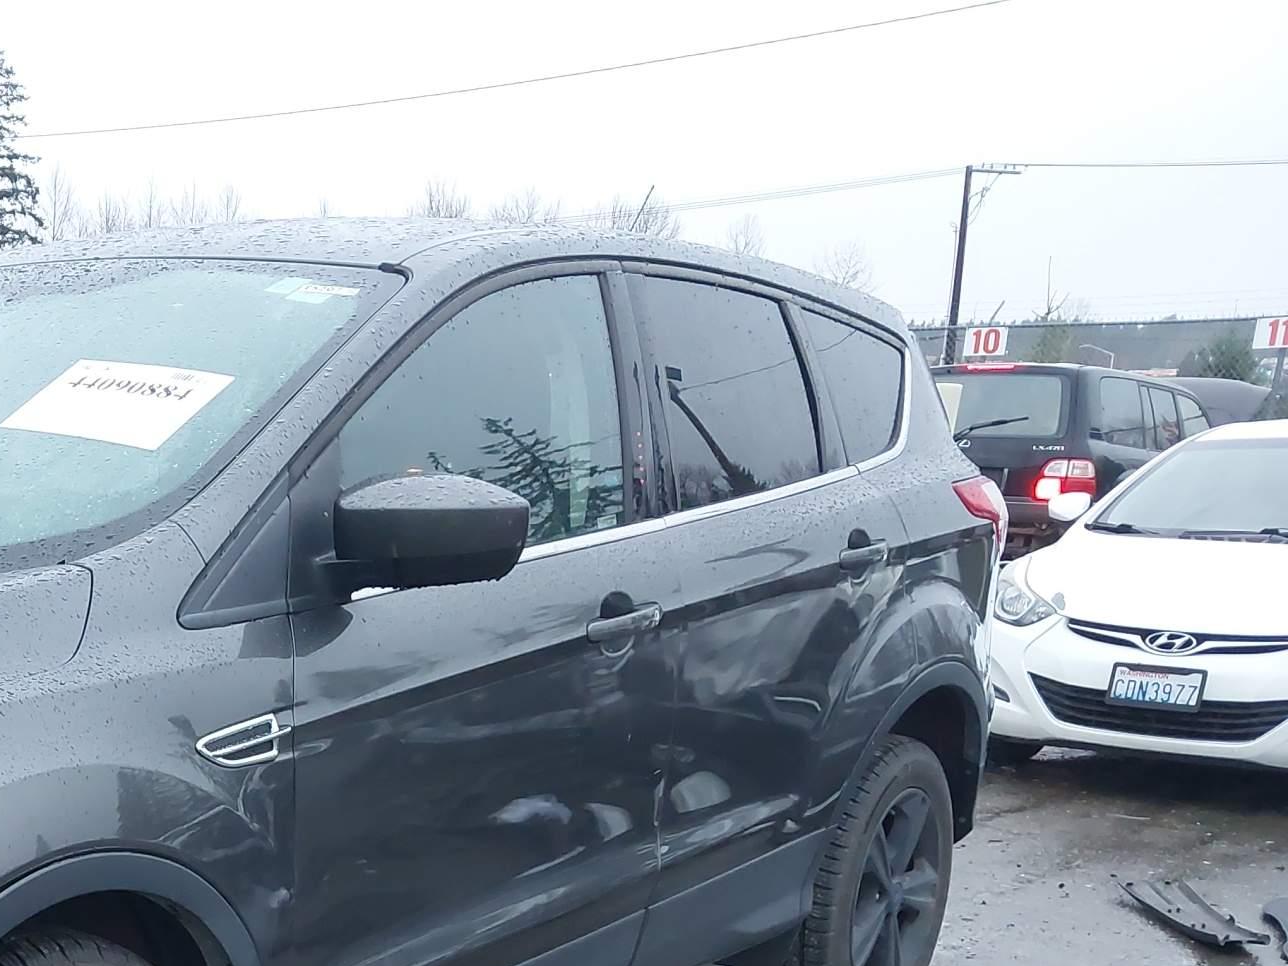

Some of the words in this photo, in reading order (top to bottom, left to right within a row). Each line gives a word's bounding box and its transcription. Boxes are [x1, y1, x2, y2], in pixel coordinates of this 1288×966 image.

[972, 328, 1001, 354] 10
[68, 375, 194, 401] 44090884
[1113, 678, 1199, 705] CDN3977
